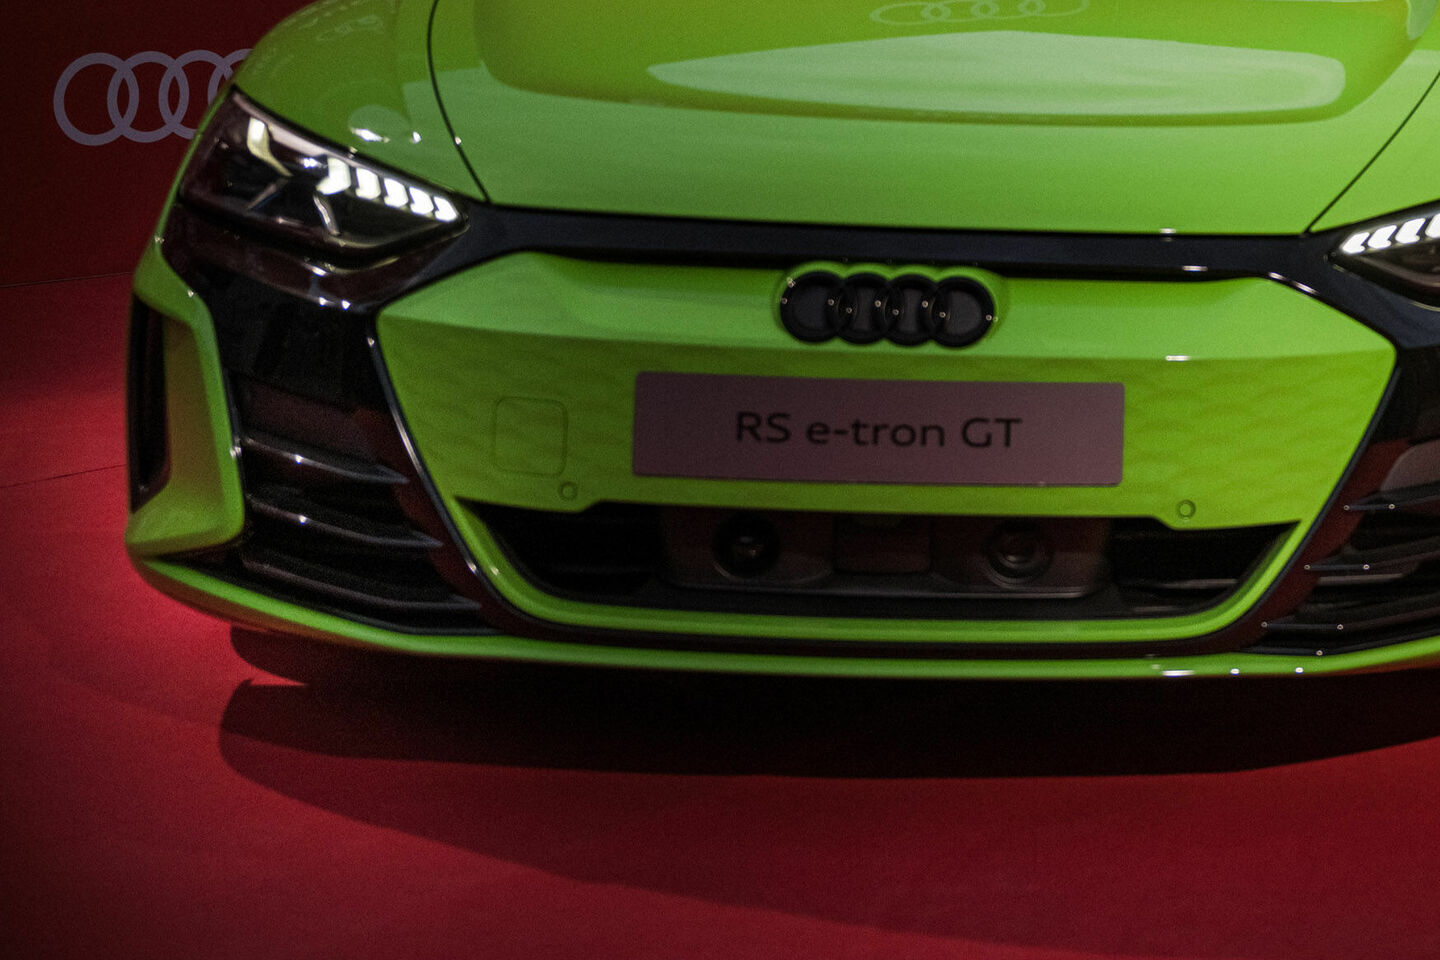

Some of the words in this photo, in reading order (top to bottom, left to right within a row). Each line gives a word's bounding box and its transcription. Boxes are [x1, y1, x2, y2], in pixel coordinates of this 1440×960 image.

[736, 411, 792, 444] RS
[805, 419, 946, 447] e-tron
[961, 417, 1022, 448] GT
